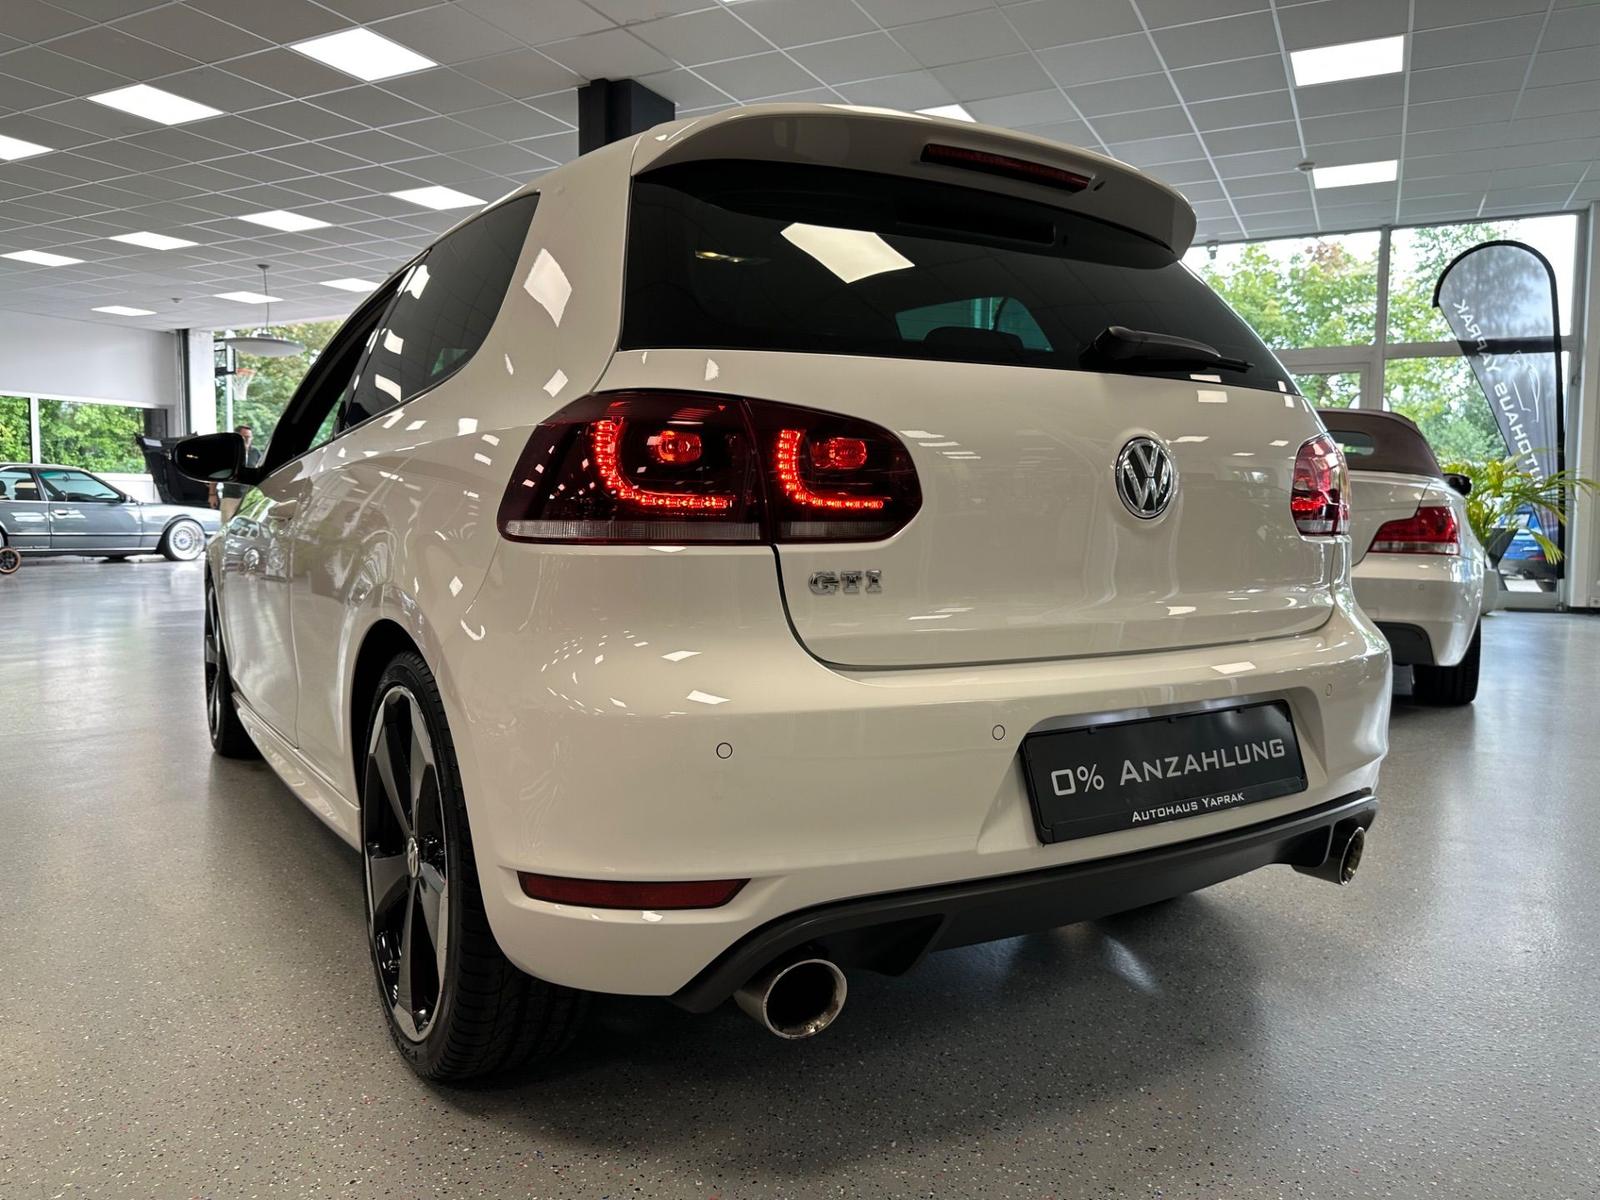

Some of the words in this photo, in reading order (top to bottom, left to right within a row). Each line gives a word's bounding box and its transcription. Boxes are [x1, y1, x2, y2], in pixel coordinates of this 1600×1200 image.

[808, 570, 882, 595] GTI
[1051, 764, 1104, 796] 0%
[1119, 738, 1285, 786] ANZAHLUNG
[1131, 800, 1198, 822] AUTOHAUS
[1201, 792, 1245, 809] YAPRAK
